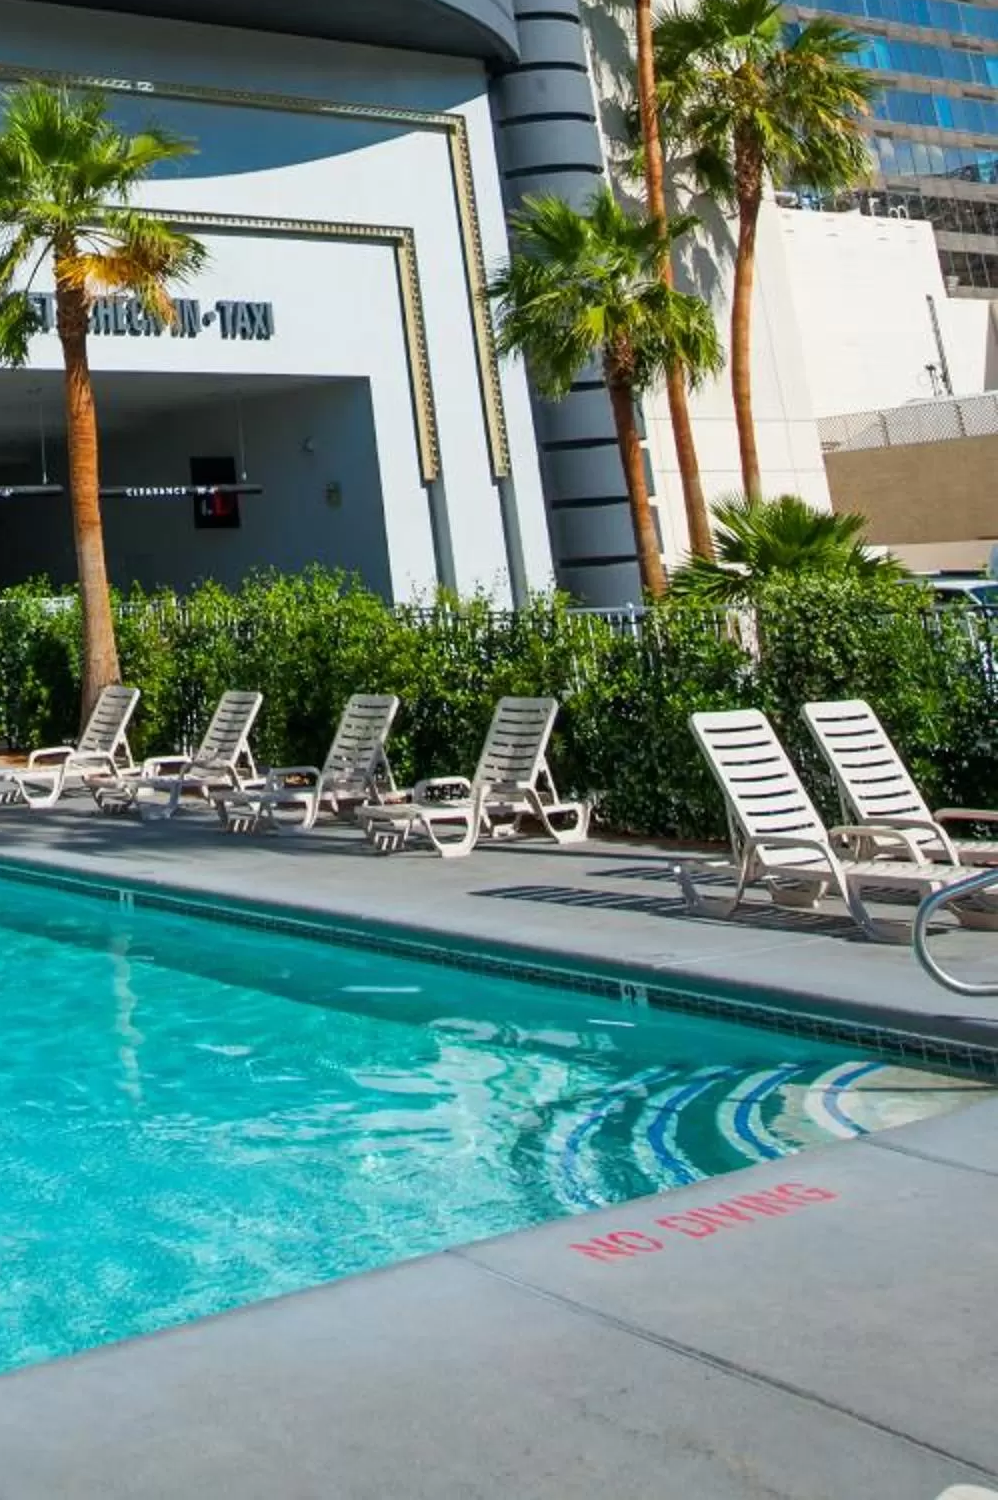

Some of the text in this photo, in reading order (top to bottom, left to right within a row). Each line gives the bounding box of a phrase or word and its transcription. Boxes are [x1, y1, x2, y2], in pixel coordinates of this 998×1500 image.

[216, 301, 274, 340] TAXI
[568, 1182, 839, 1264] NO DIVING
